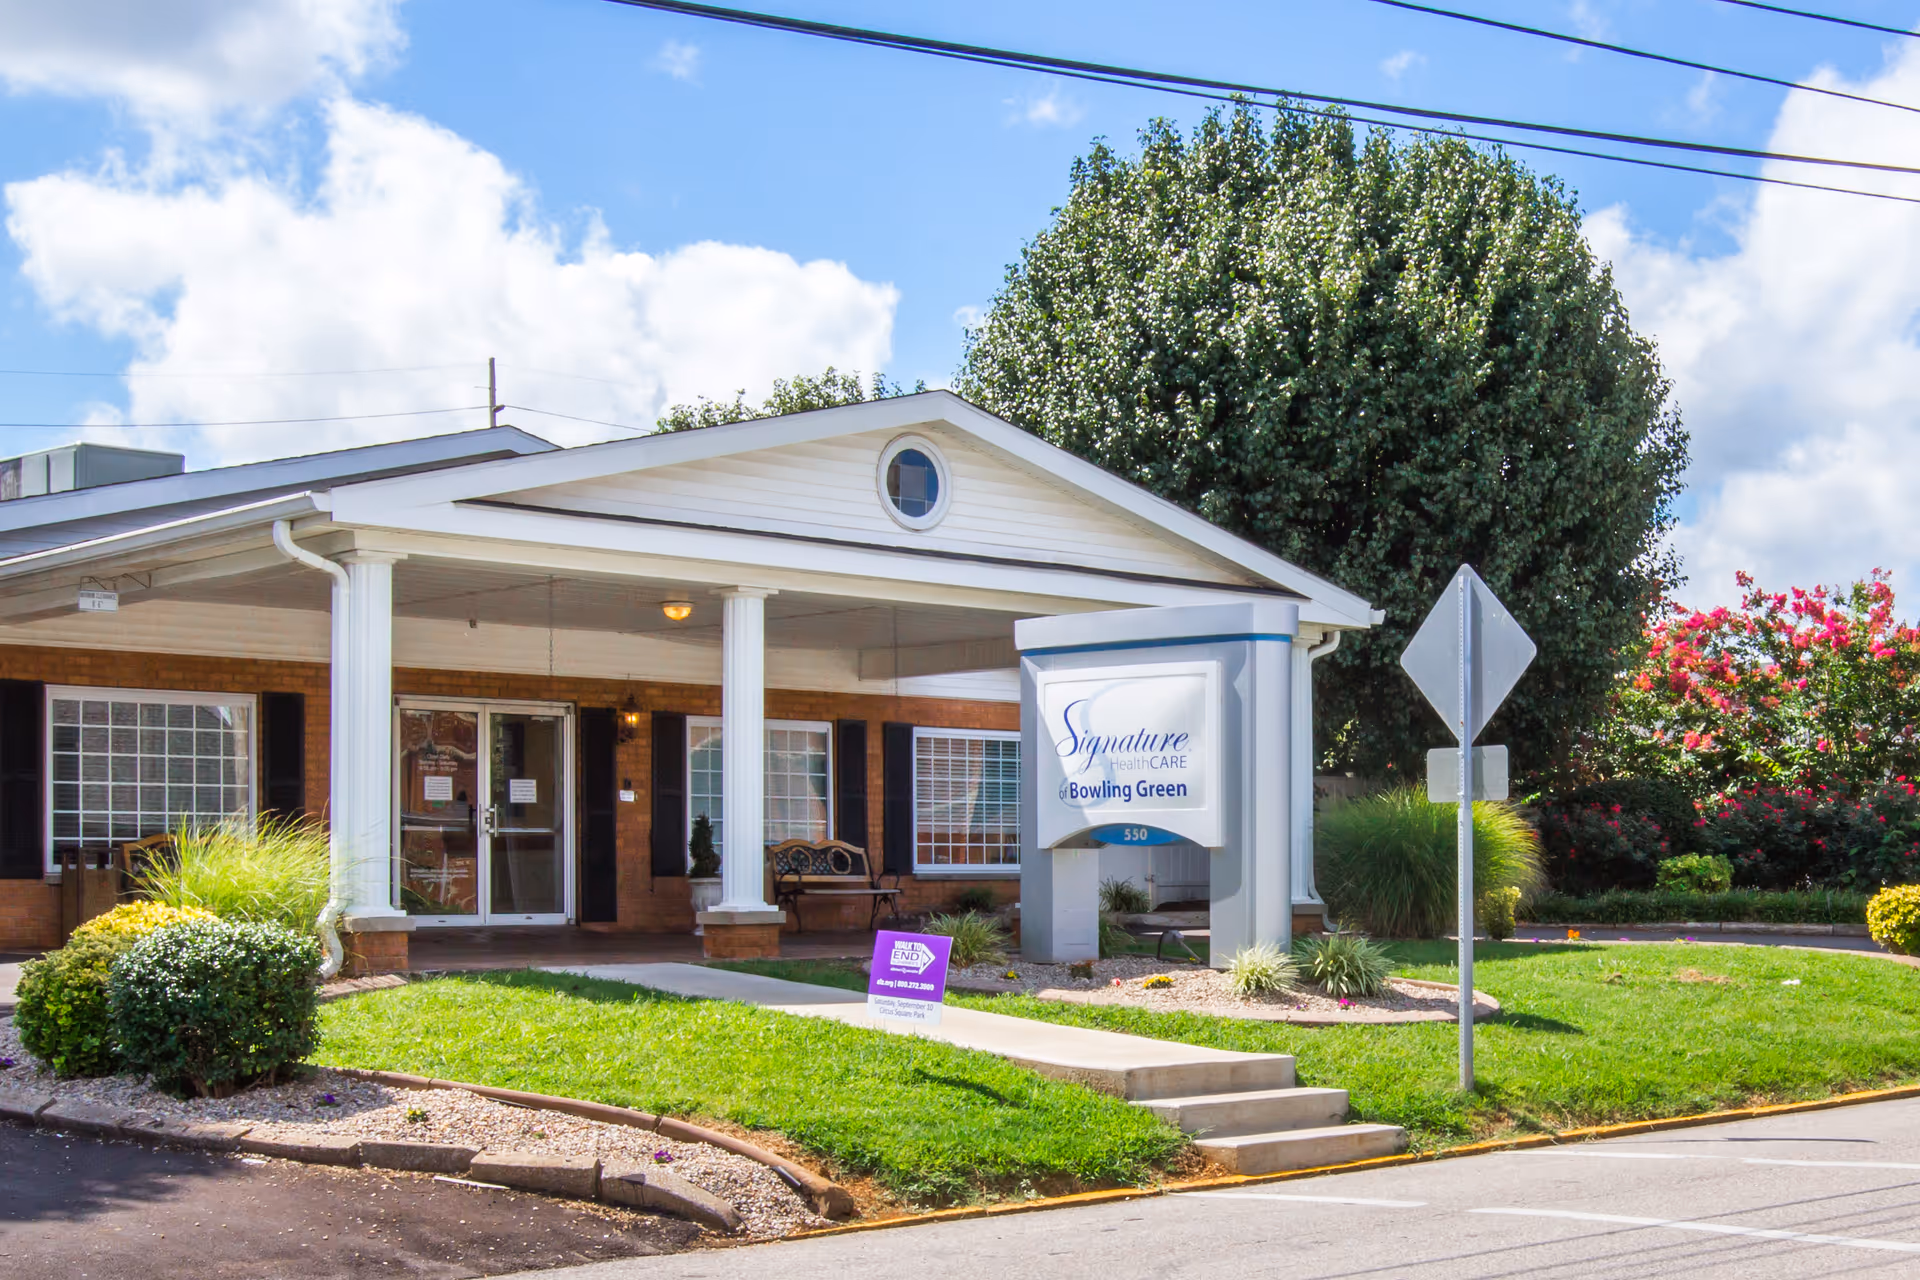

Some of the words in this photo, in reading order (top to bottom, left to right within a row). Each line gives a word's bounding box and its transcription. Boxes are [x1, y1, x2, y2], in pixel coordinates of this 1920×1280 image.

[1055, 699, 1189, 774] Signature
[1110, 755, 1187, 770] HealthCARE
[1059, 786, 1068, 800] of
[1070, 780, 1132, 802] Bowling
[1136, 780, 1187, 797] Green
[1124, 828, 1148, 841] 550
[895, 940, 912, 950] WALK
[913, 942, 921, 952] TO
[893, 951, 920, 961] END
[913, 1011, 925, 1019] Park
